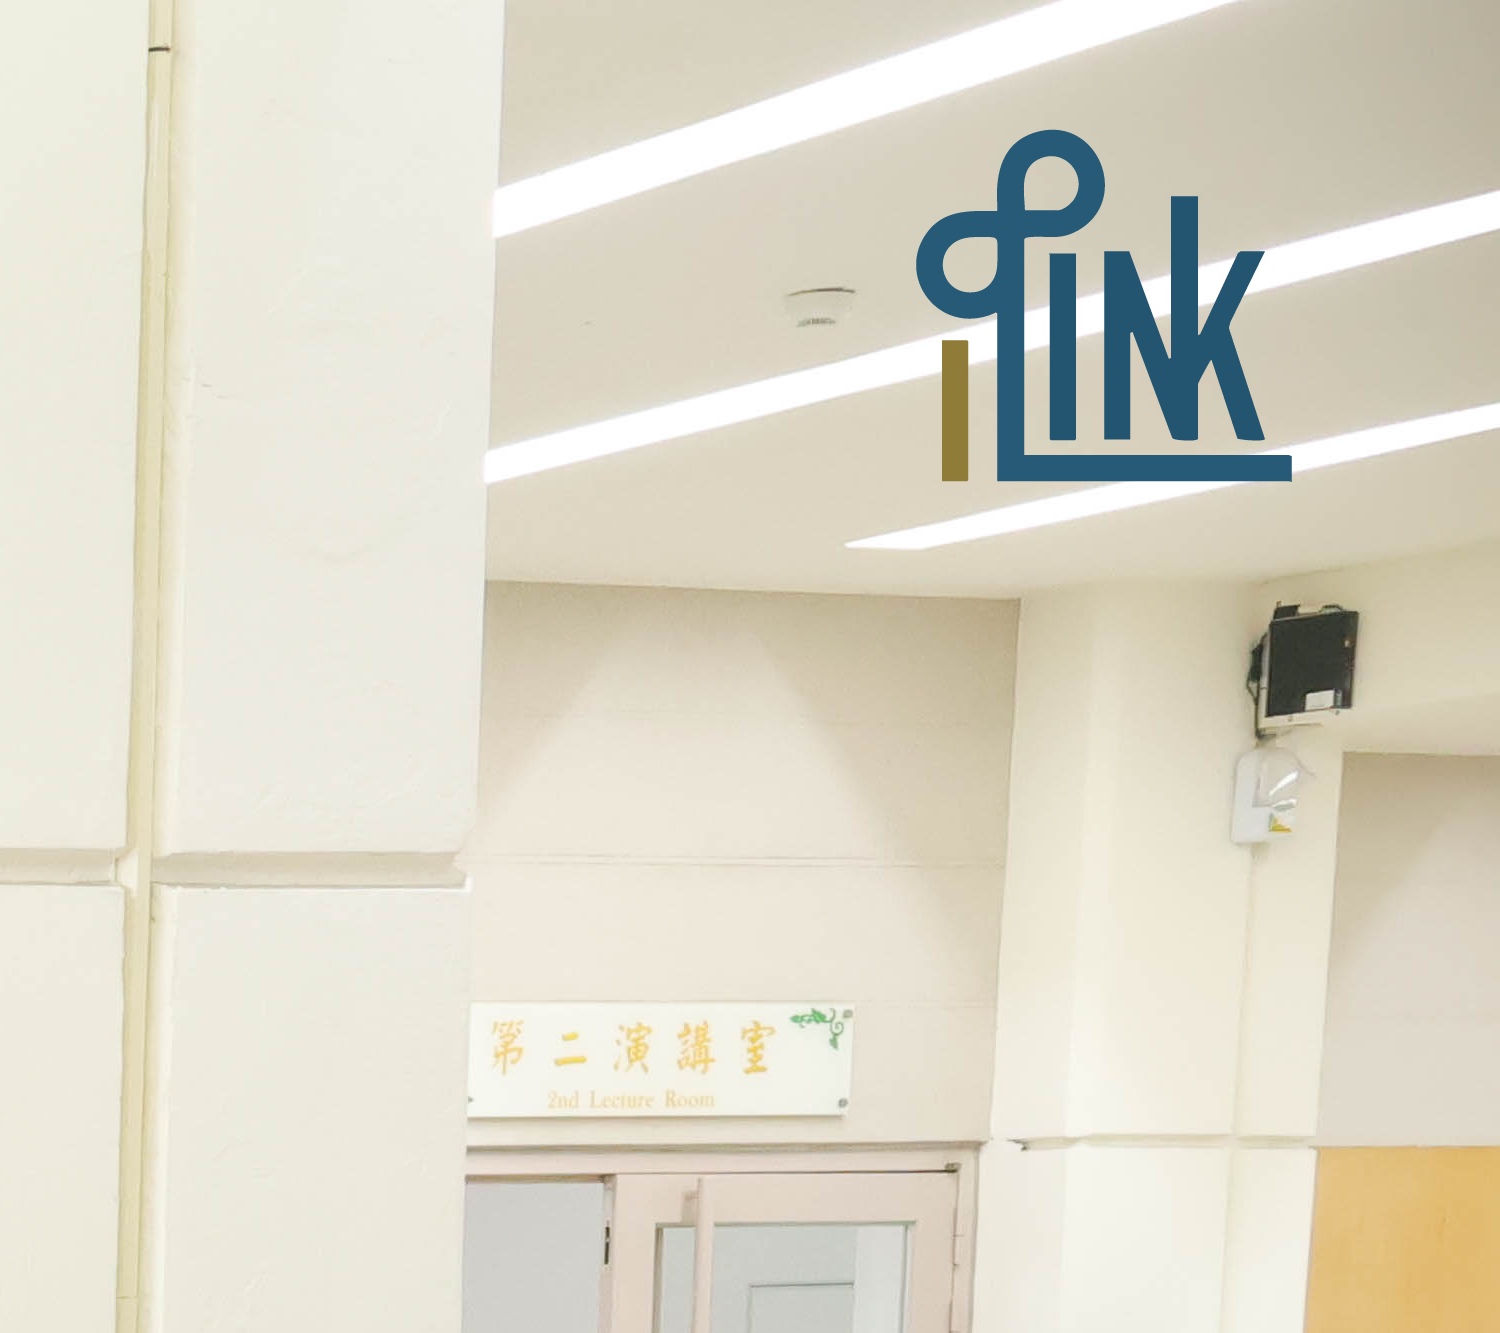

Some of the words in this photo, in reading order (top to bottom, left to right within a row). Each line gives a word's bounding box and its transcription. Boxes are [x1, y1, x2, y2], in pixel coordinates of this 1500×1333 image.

[491, 1020, 777, 1076] 第二演講室
[547, 1090, 579, 1110] 2nd
[589, 1090, 655, 1109] Lecture
[664, 1090, 716, 1109] Room
